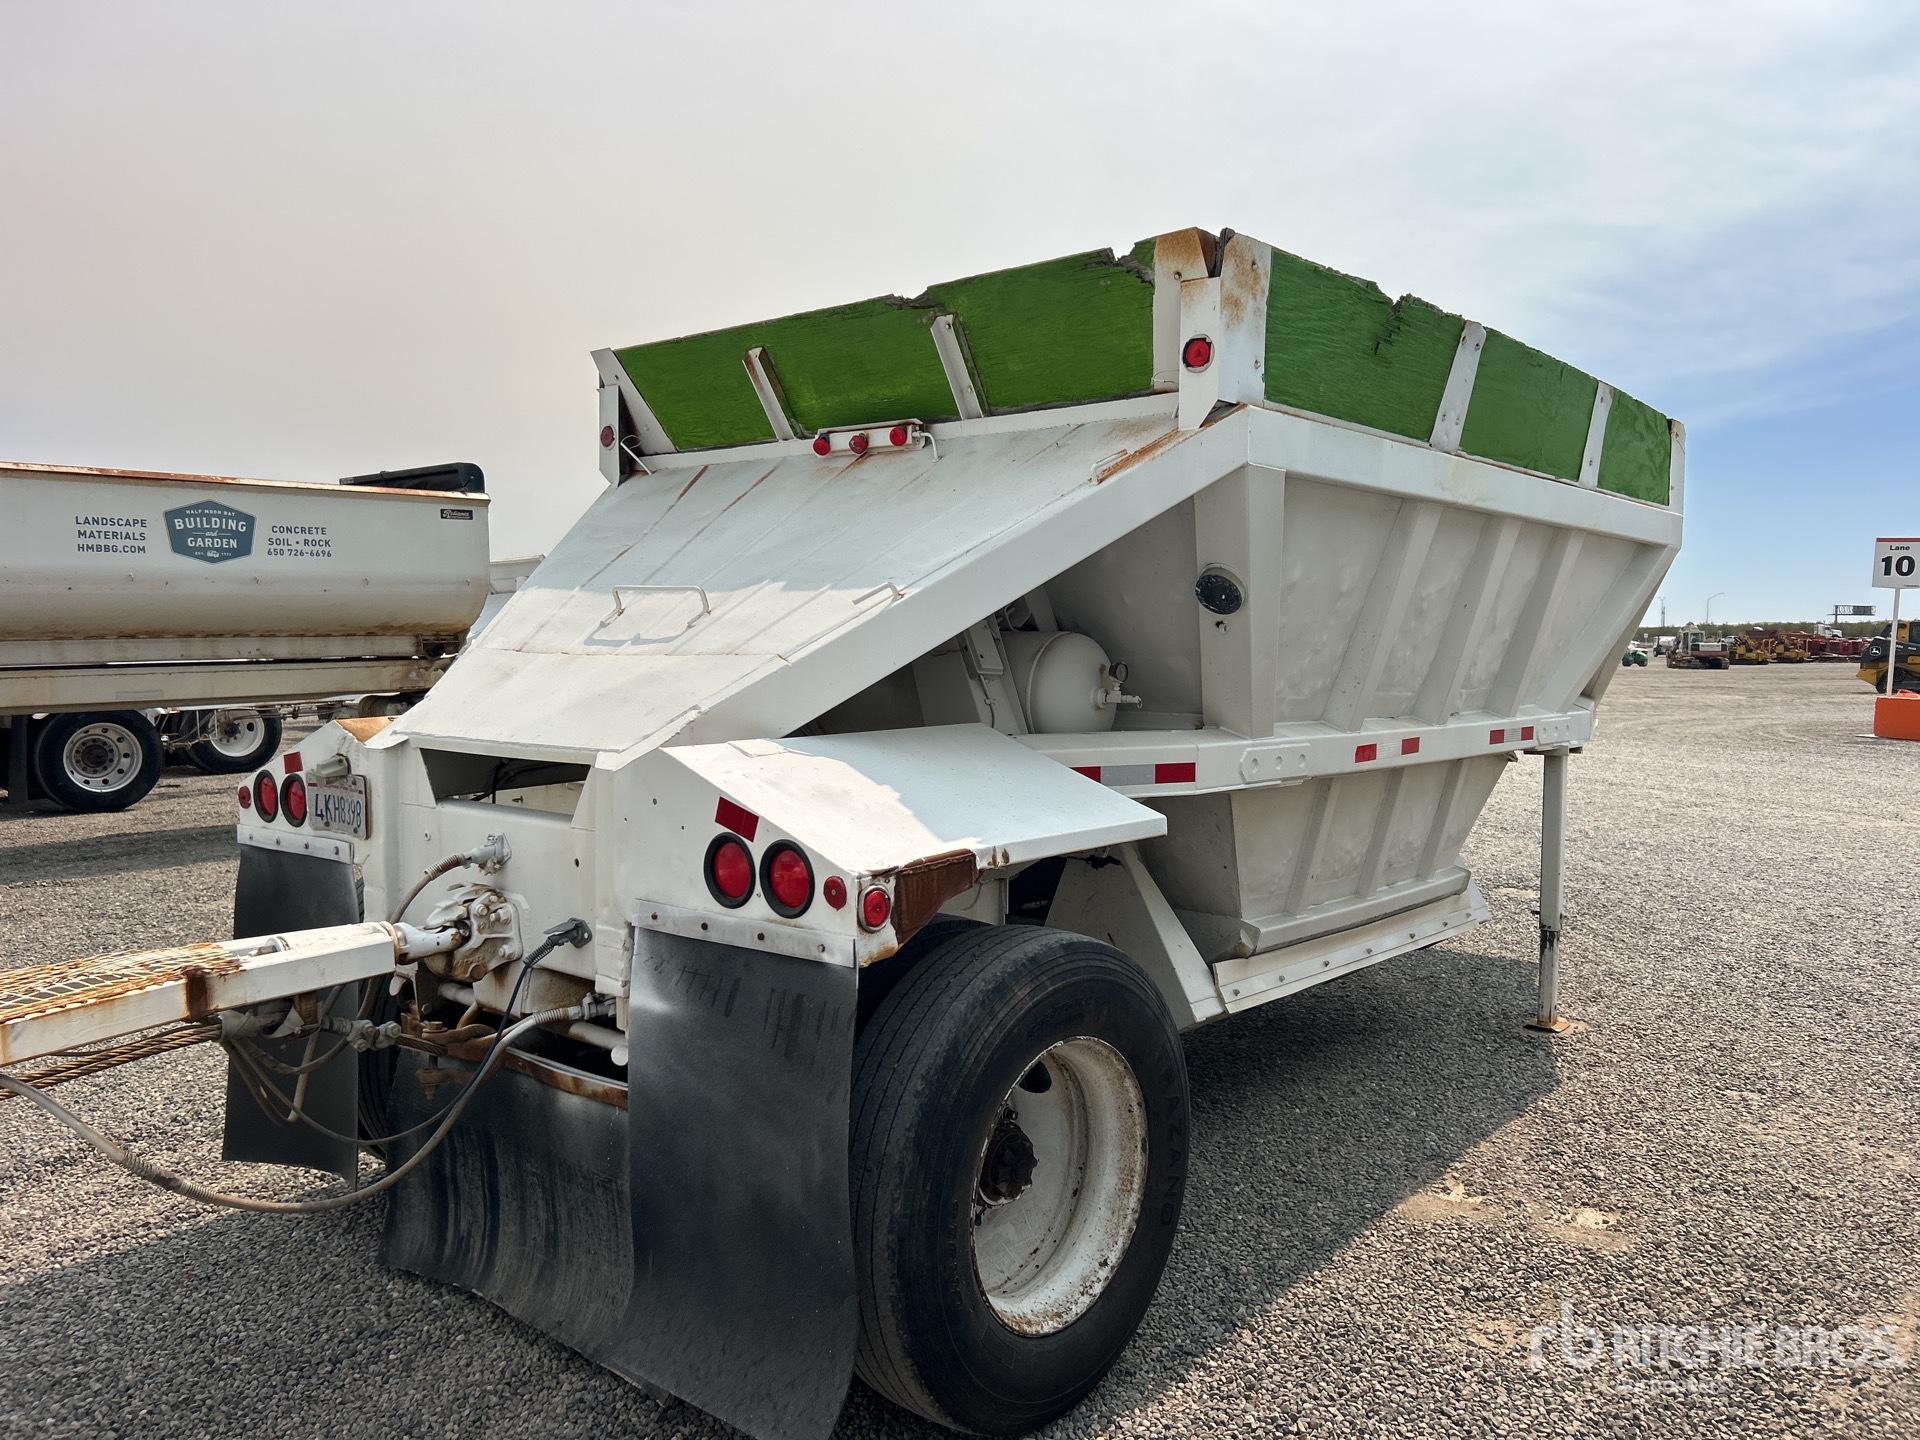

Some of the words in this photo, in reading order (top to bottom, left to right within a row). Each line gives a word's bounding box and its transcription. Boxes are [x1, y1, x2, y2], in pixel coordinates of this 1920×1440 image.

[75, 515, 148, 528] LANDSCAPE
[174, 517, 247, 532] BUILDING
[77, 529, 146, 541] MATERIALS
[271, 525, 327, 536] CONCRETE
[77, 543, 146, 554] HMBBG.COM
[187, 537, 238, 549] GARDEN
[268, 537, 293, 547] SOIL
[303, 538, 332, 548] ROCK
[267, 548, 285, 556] 650
[287, 548, 332, 558] 726-6696
[1881, 555, 1916, 577] 10
[315, 793, 362, 828] 4KH8398
